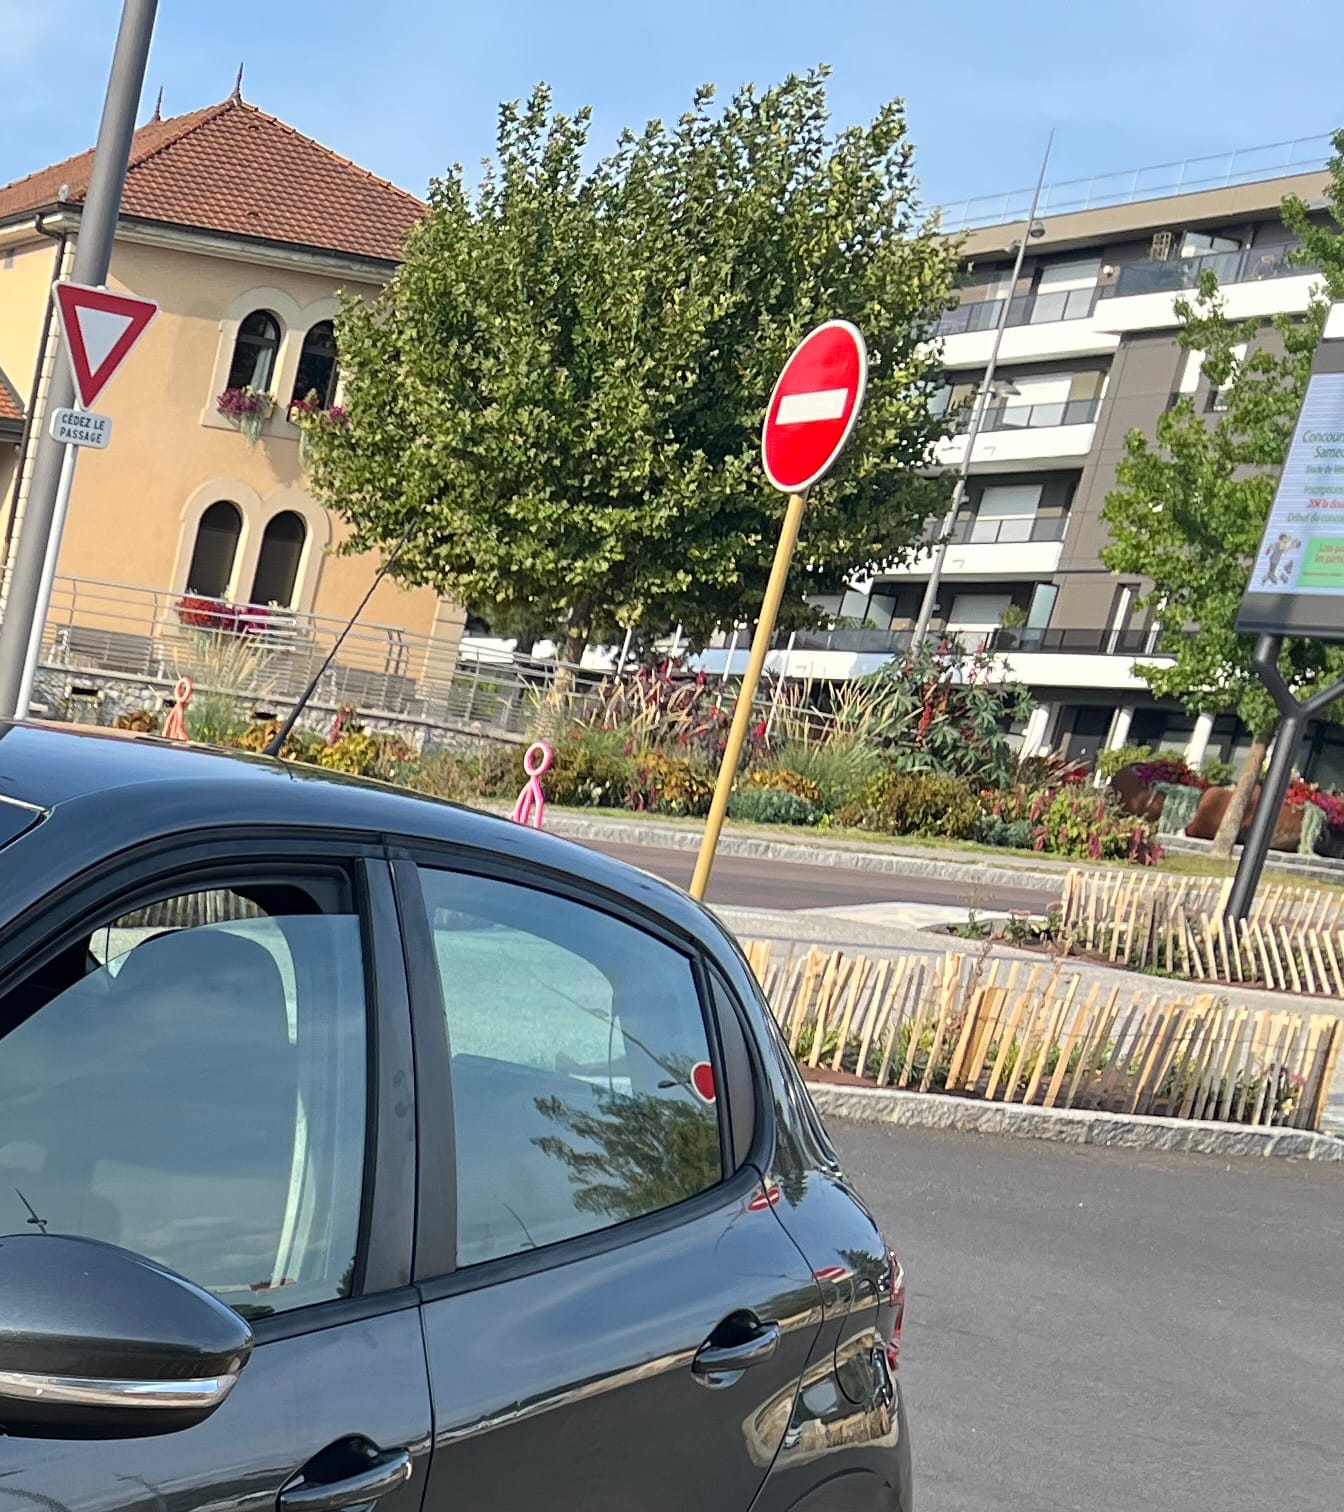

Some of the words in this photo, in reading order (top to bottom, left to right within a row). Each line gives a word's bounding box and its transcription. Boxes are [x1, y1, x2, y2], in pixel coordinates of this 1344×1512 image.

[62, 412, 91, 428] CÉDEZ
[94, 420, 105, 431] LE
[59, 426, 103, 444] PASSAGE
[1303, 430, 1344, 443] Concour
